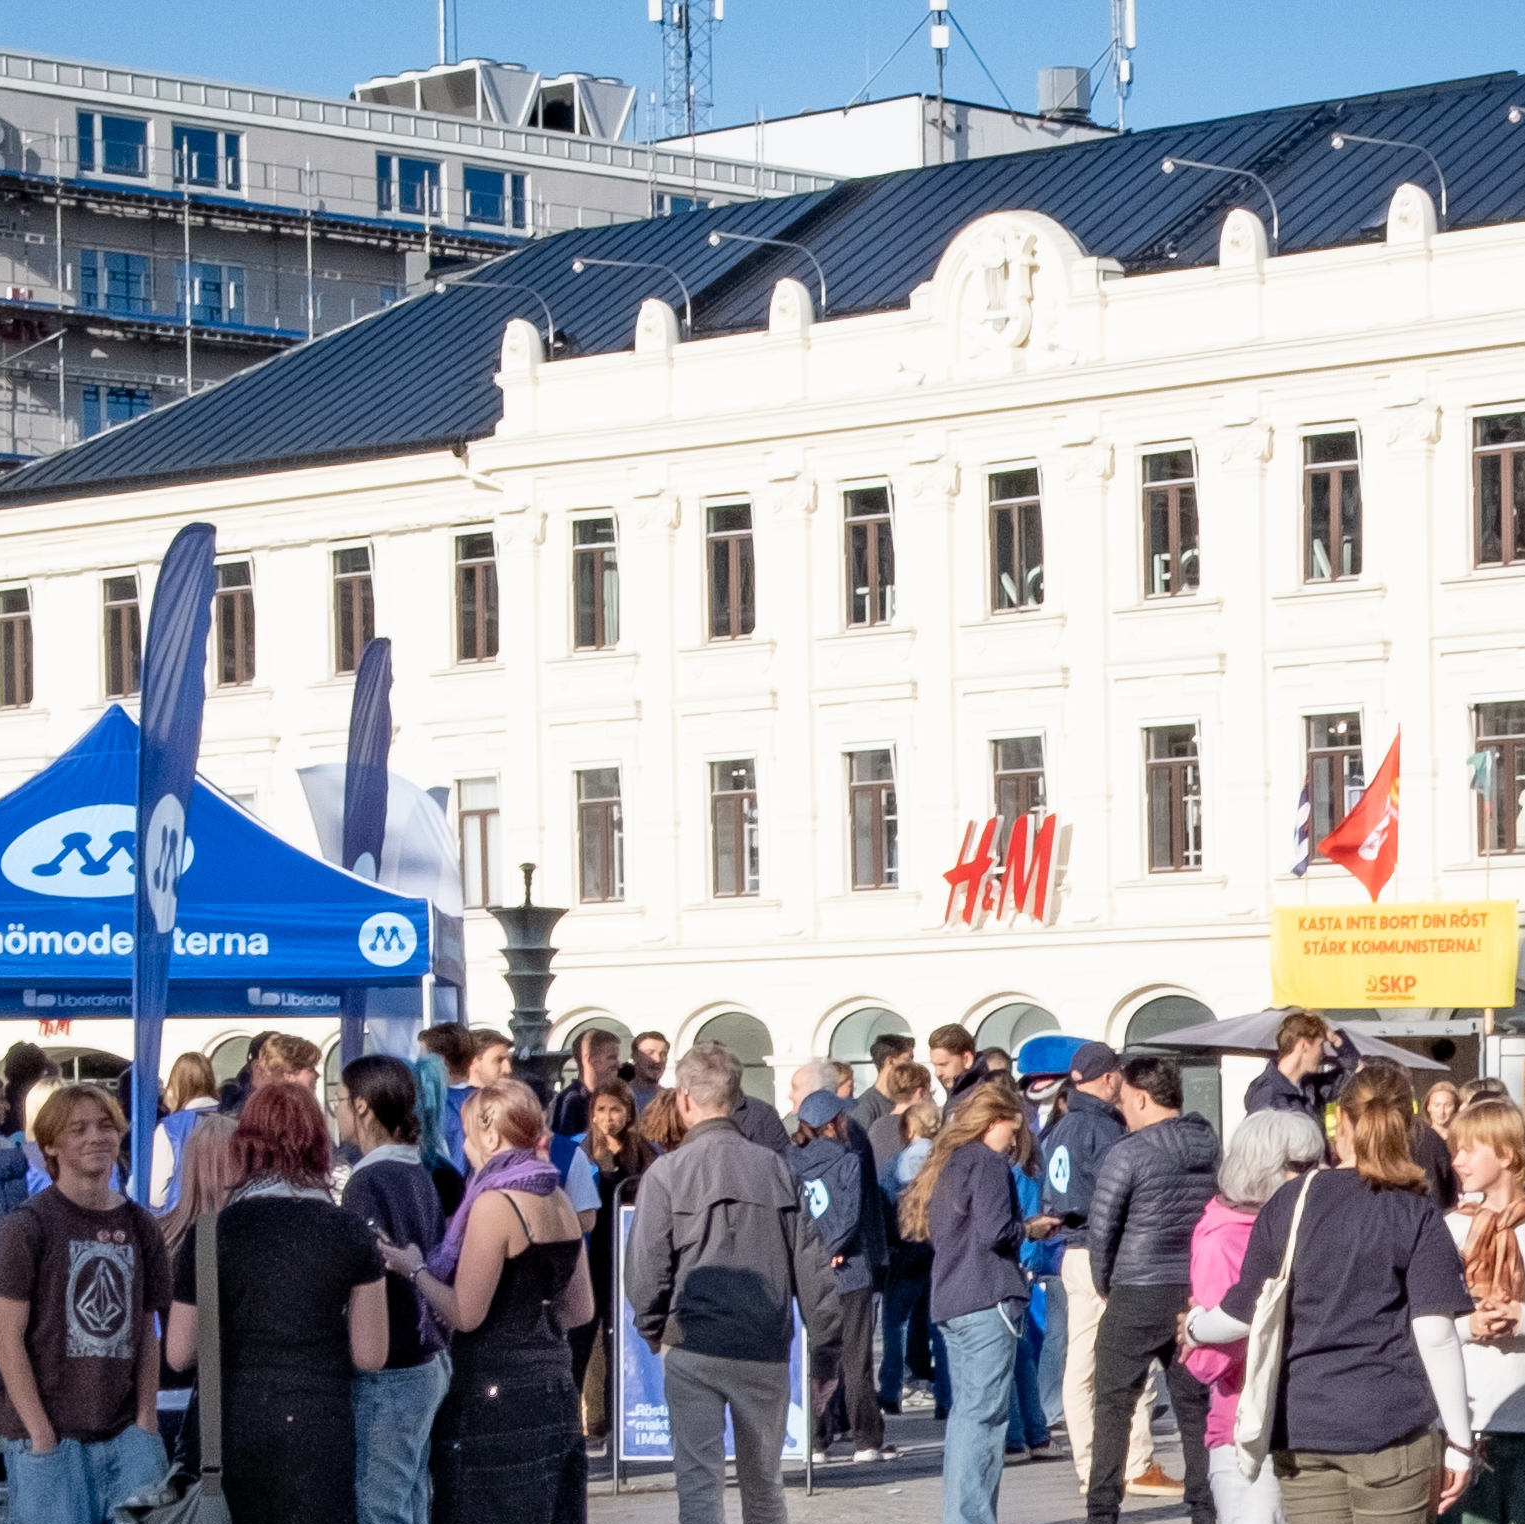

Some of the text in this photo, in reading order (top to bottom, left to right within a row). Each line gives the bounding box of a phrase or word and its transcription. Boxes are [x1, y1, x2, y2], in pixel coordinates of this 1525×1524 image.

[942, 813, 1057, 926] H&M
[1298, 909, 1488, 932] KASTA INTE BORT DIN RÖST
[1303, 936, 1482, 955] STÄRK KOMMUNISTERNA!
[1378, 975, 1417, 993] SKP
